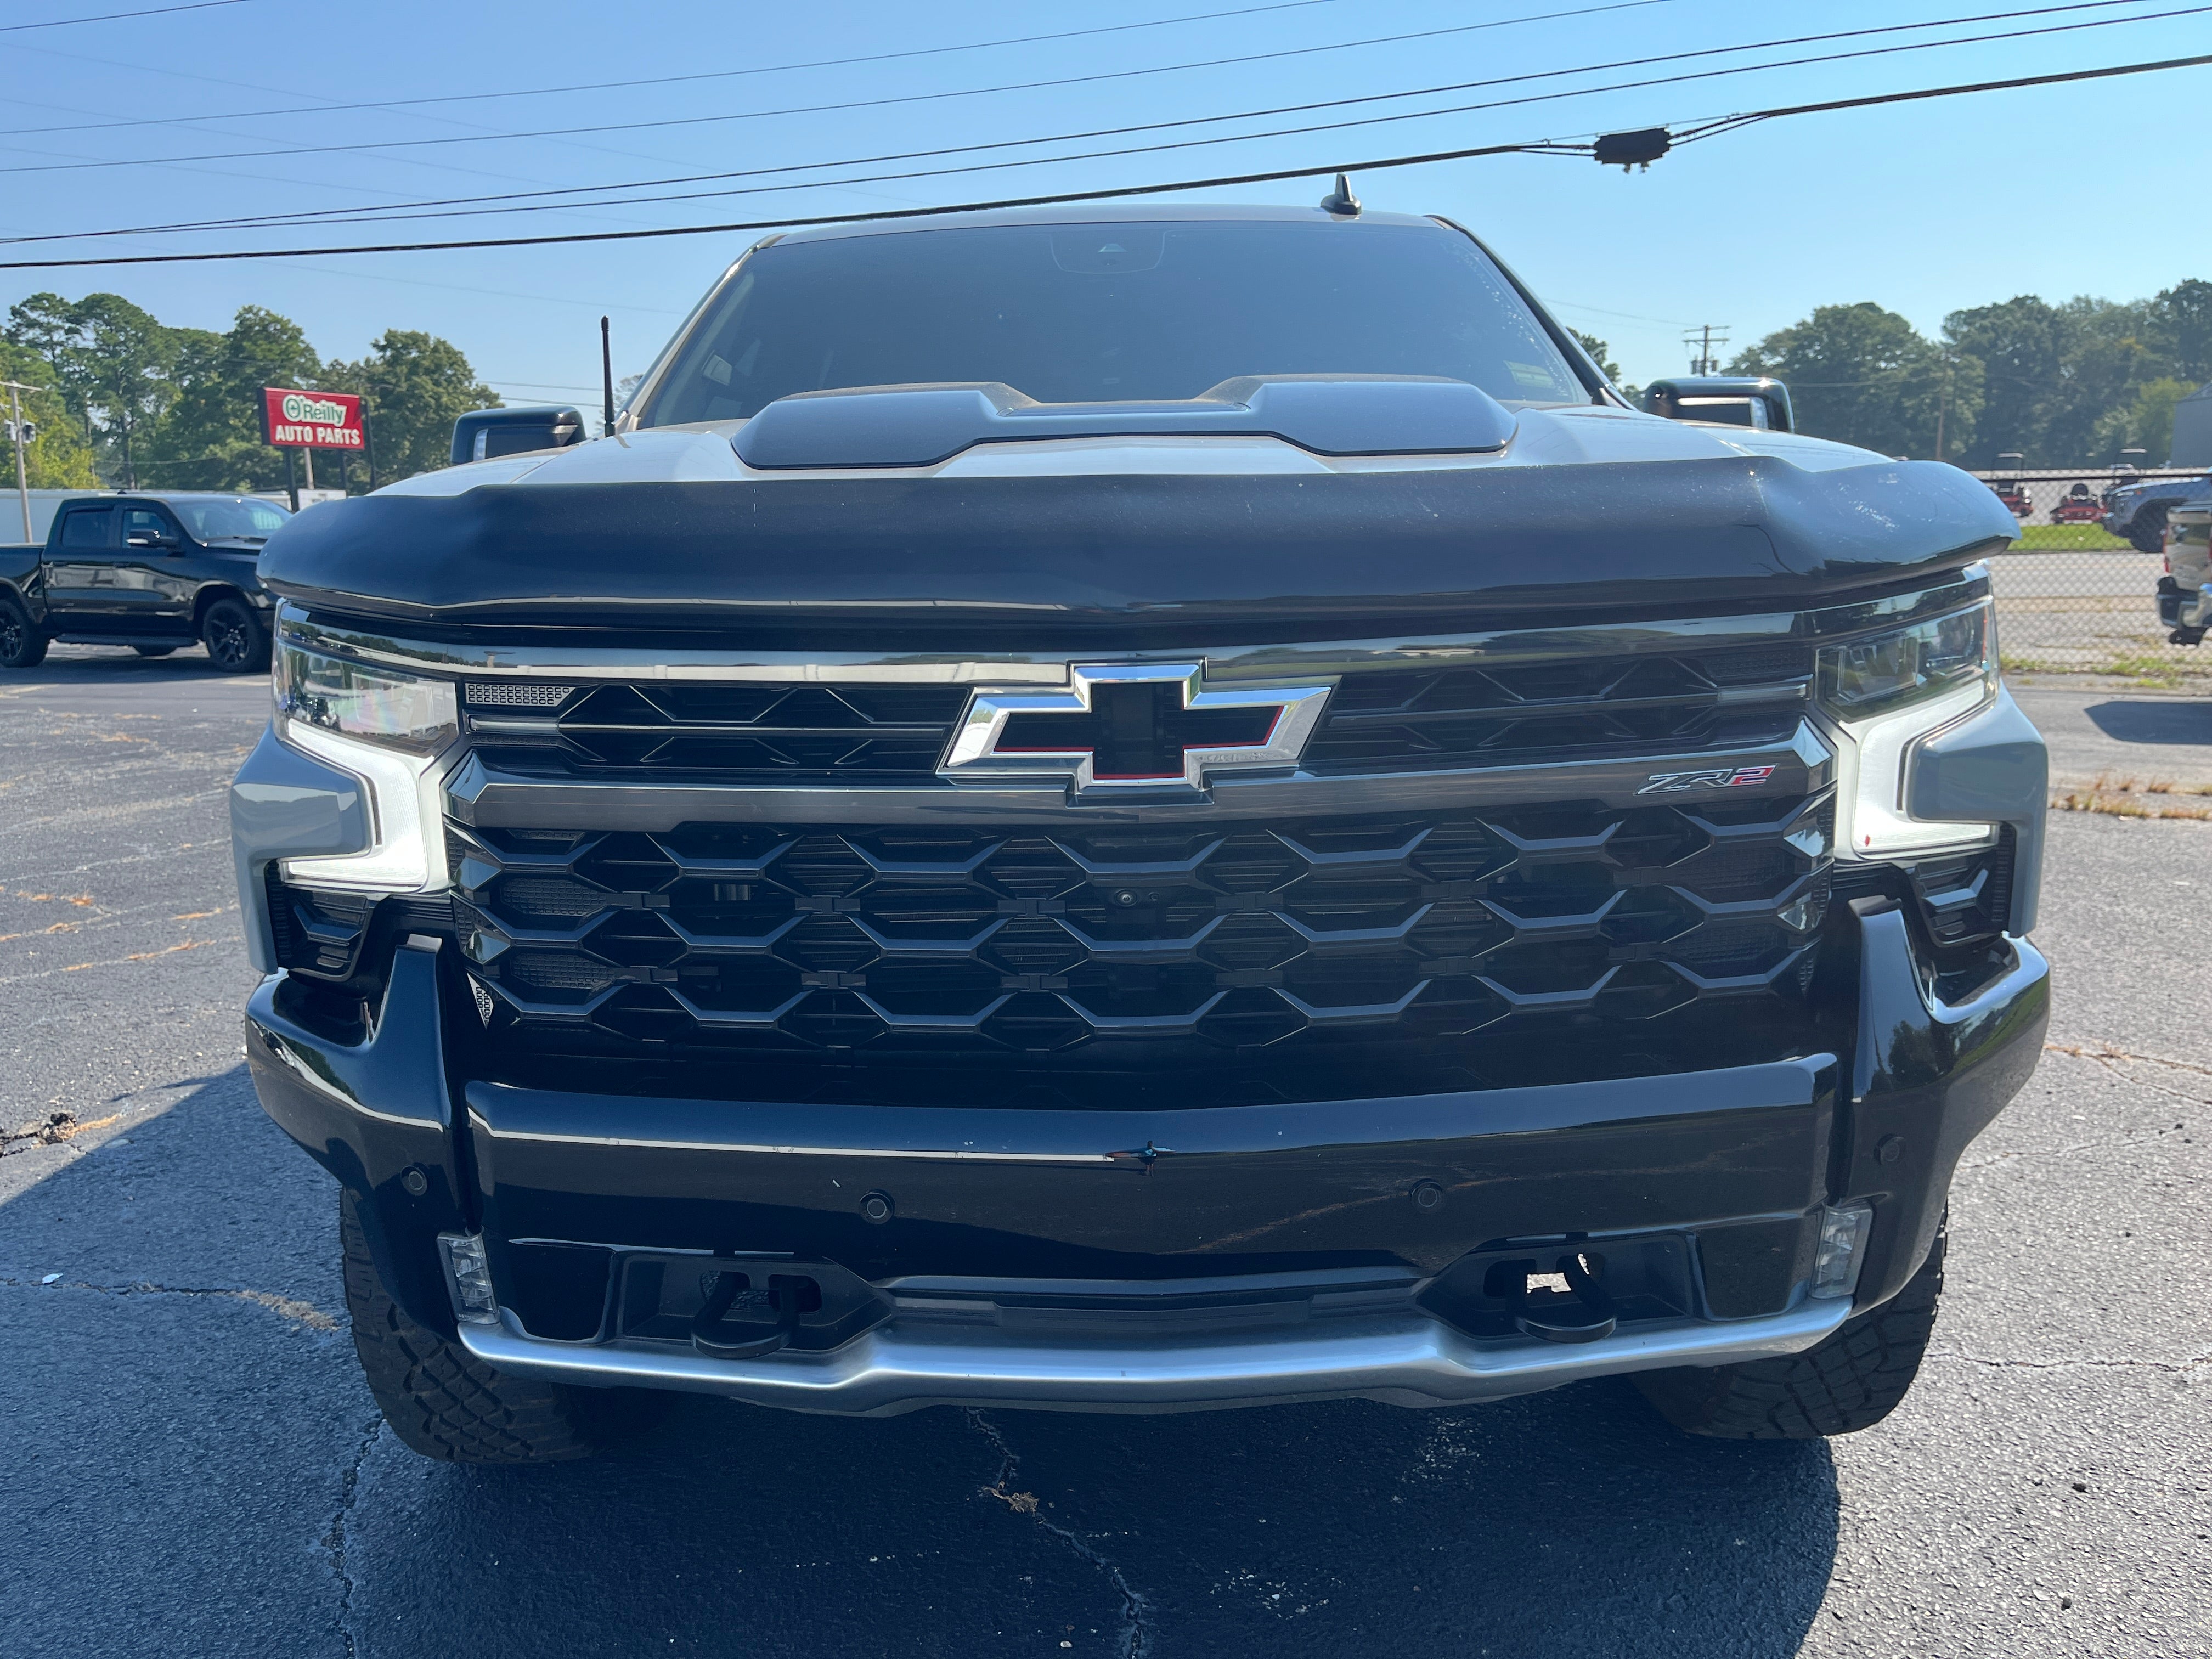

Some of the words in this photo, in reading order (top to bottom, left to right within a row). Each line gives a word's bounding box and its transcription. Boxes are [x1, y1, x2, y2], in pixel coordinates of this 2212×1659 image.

[275, 425, 313, 442] AUTO
[316, 427, 360, 445] PARTS
[1635, 764, 1778, 795] ZR2
